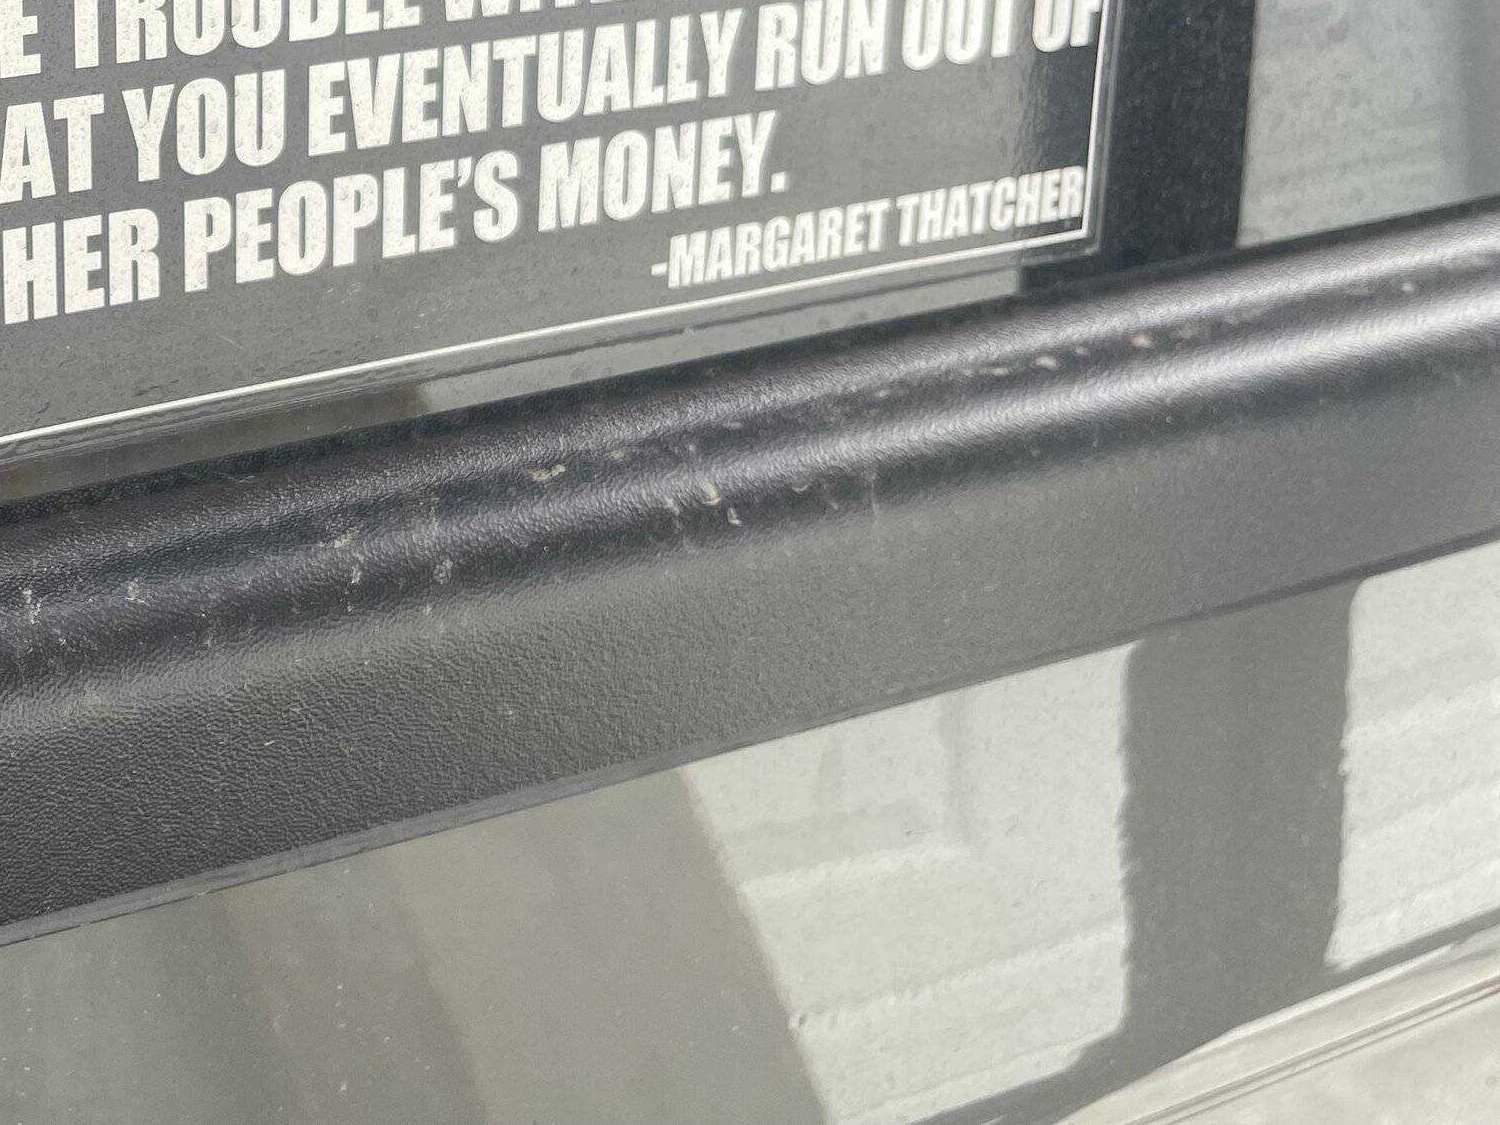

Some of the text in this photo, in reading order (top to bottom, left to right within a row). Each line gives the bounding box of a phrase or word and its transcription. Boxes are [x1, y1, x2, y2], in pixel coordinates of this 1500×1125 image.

[122, 69, 285, 183] YOU
[307, 8, 743, 157] EVENTUALLY
[537, 110, 789, 233] MONEY.
[650, 166, 1086, 290] -MARGARET THATCHER
